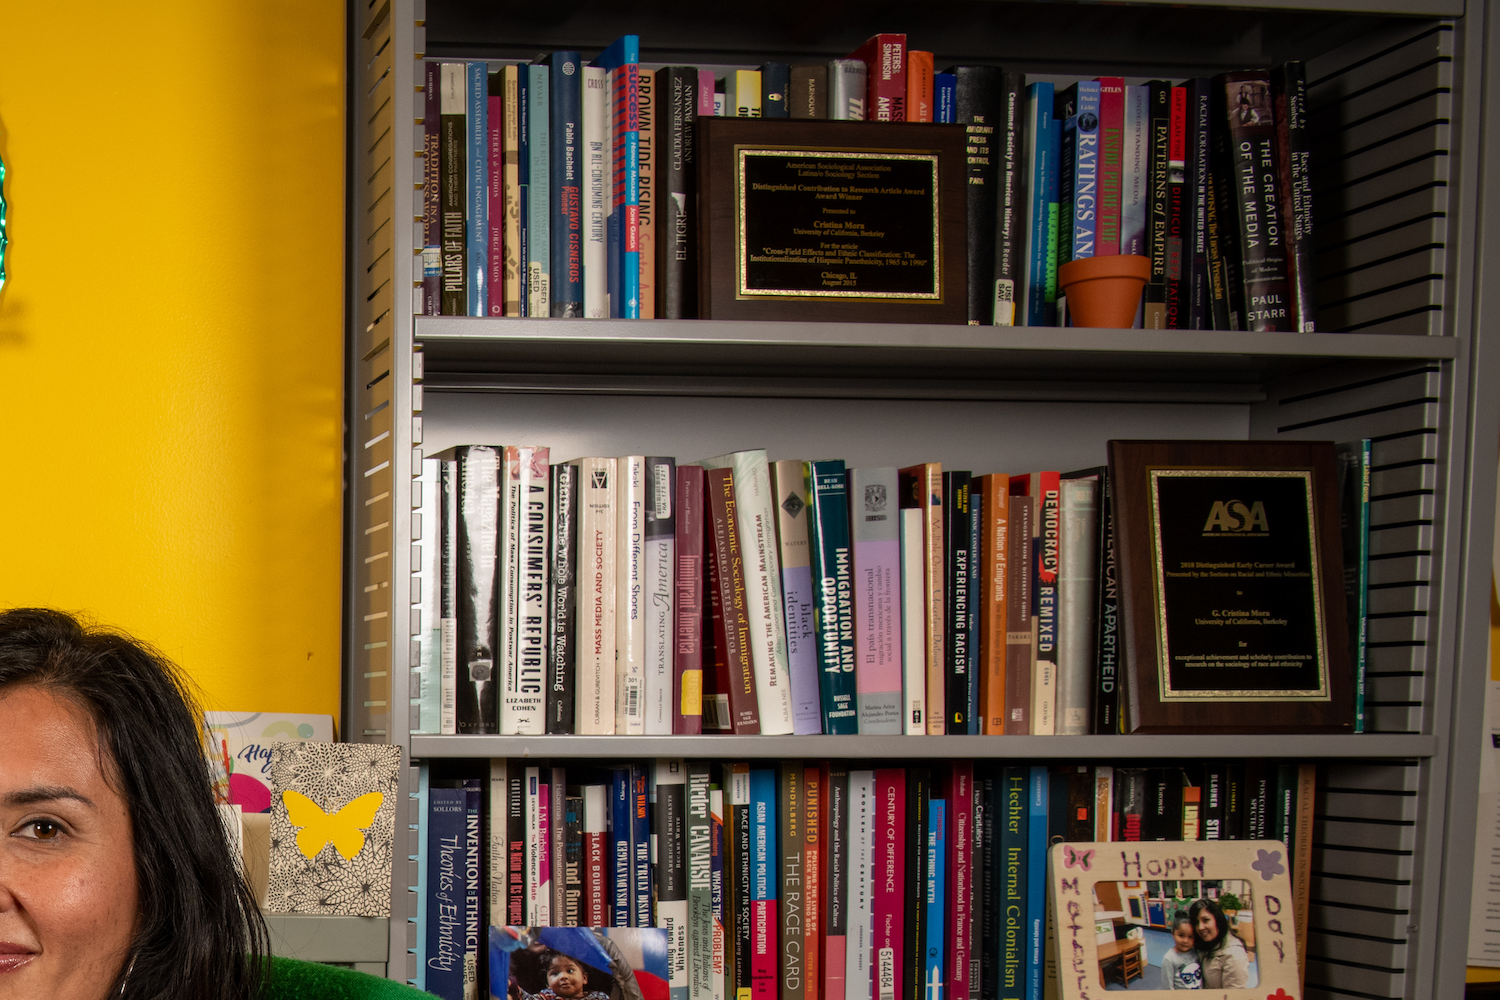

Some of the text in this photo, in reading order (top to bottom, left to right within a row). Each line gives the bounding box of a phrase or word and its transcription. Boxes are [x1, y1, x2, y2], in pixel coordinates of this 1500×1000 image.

[882, 43, 892, 81] SIMONSON
[628, 64, 638, 132] SUCCESS
[566, 122, 576, 182] Pablo Bachelet
[1076, 134, 1096, 223] RATINGS
[1240, 140, 1260, 249] OF THE MEDIA
[1260, 138, 1279, 248] THE CREATION
[568, 186, 580, 284] GUSTAVO CISNEROS
[676, 212, 687, 262] EL TIGRE
[1247, 308, 1286, 322] STARR
[1252, 294, 1282, 306] PAUL
[1202, 499, 1270, 533] ASA
[595, 530, 604, 655] MASS MEDIA AND SOCIETY
[1038, 490, 1060, 654] DEMOCRACY REMIXED
[786, 590, 798, 655] identities
[800, 600, 813, 640] black
[836, 548, 854, 674] IMMIGRATION AND
[954, 549, 968, 675] EXPERIENCING RACISM
[1102, 604, 1118, 695] APARTHEID
[637, 794, 647, 819] WILSON
[1210, 774, 1220, 808] BLAUNER
[592, 831, 600, 863] BLACK
[1004, 776, 1024, 990] Hechter Internal Colonialism
[786, 852, 801, 992] THE RACE CARD
